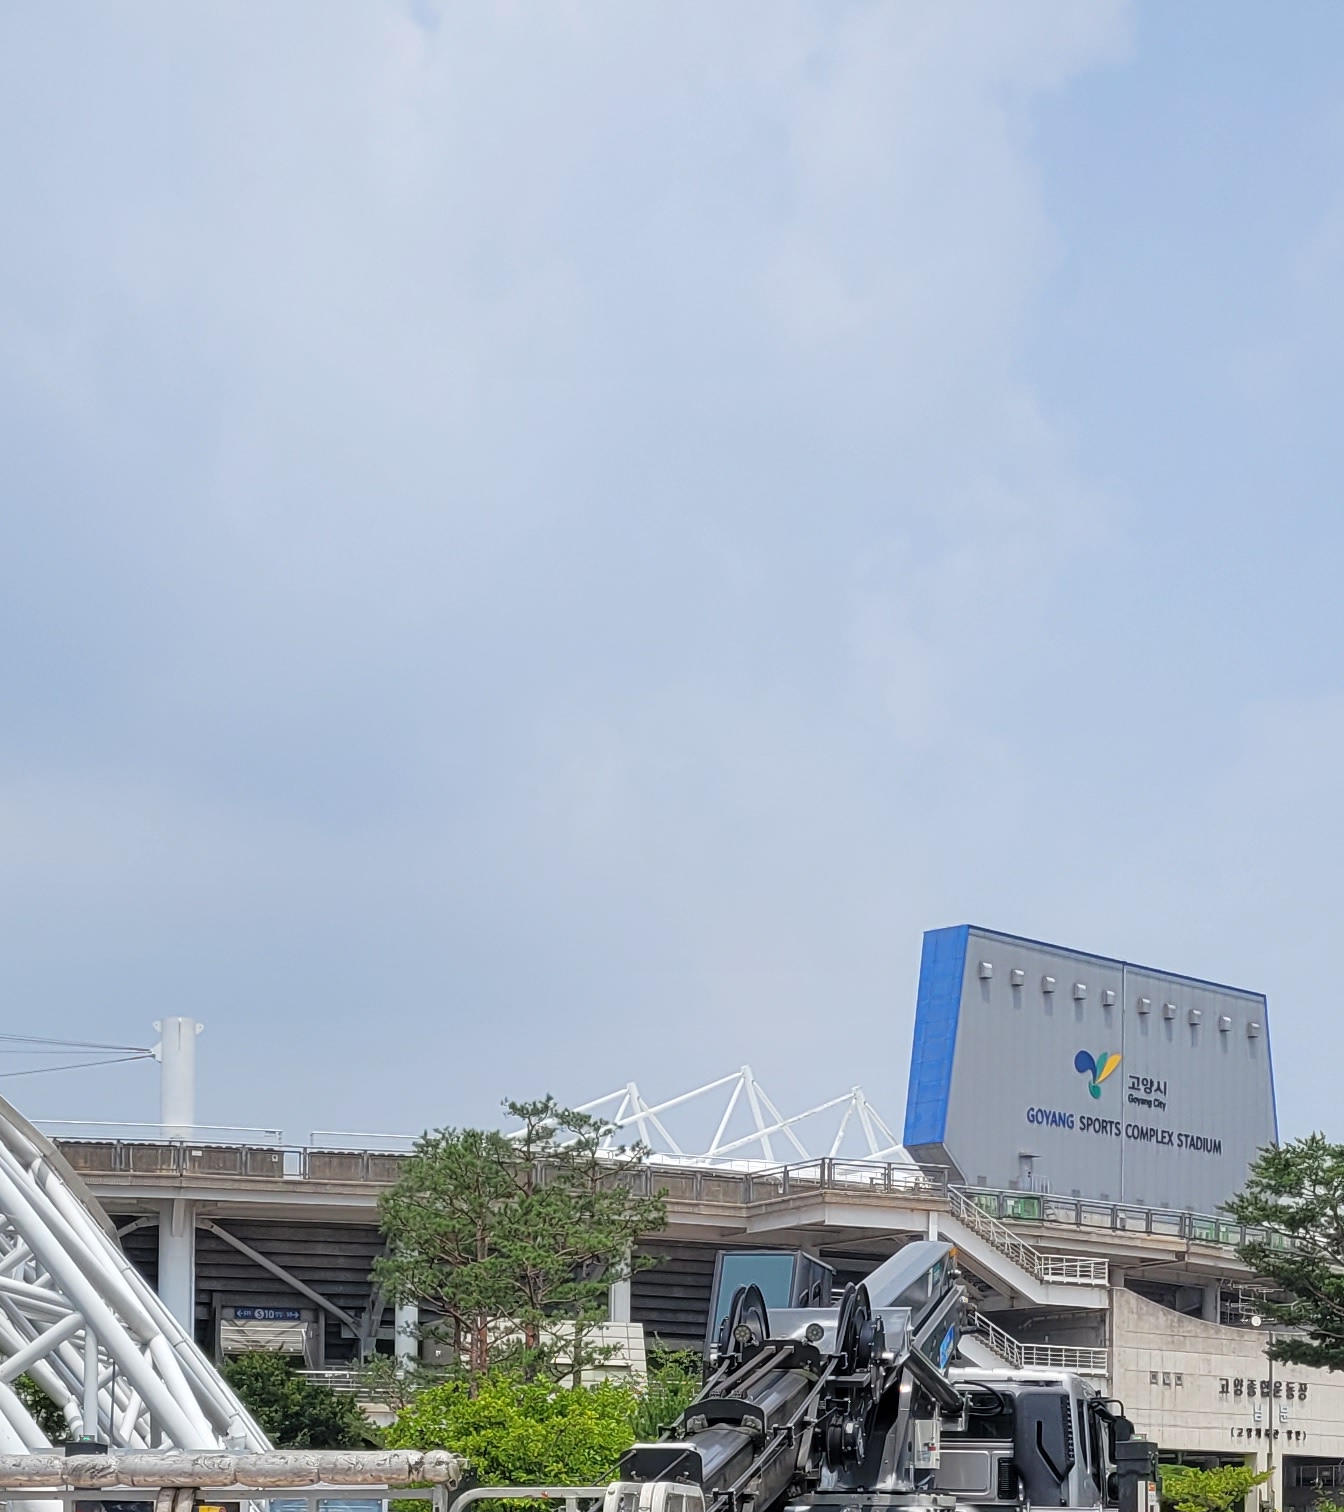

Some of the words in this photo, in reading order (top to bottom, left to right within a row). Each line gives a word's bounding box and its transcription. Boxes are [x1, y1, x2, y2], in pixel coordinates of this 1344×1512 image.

[1128, 1074, 1168, 1098] 고양시
[1128, 1093, 1152, 1109] Goyang
[1153, 1097, 1167, 1113] City
[1027, 1106, 1075, 1129] GOYANG
[1079, 1115, 1121, 1137] SPORTS
[1125, 1123, 1175, 1147] COMPLEX
[1177, 1132, 1223, 1156] STADIUM
[1219, 1378, 1308, 1401] 고양종합운동장
